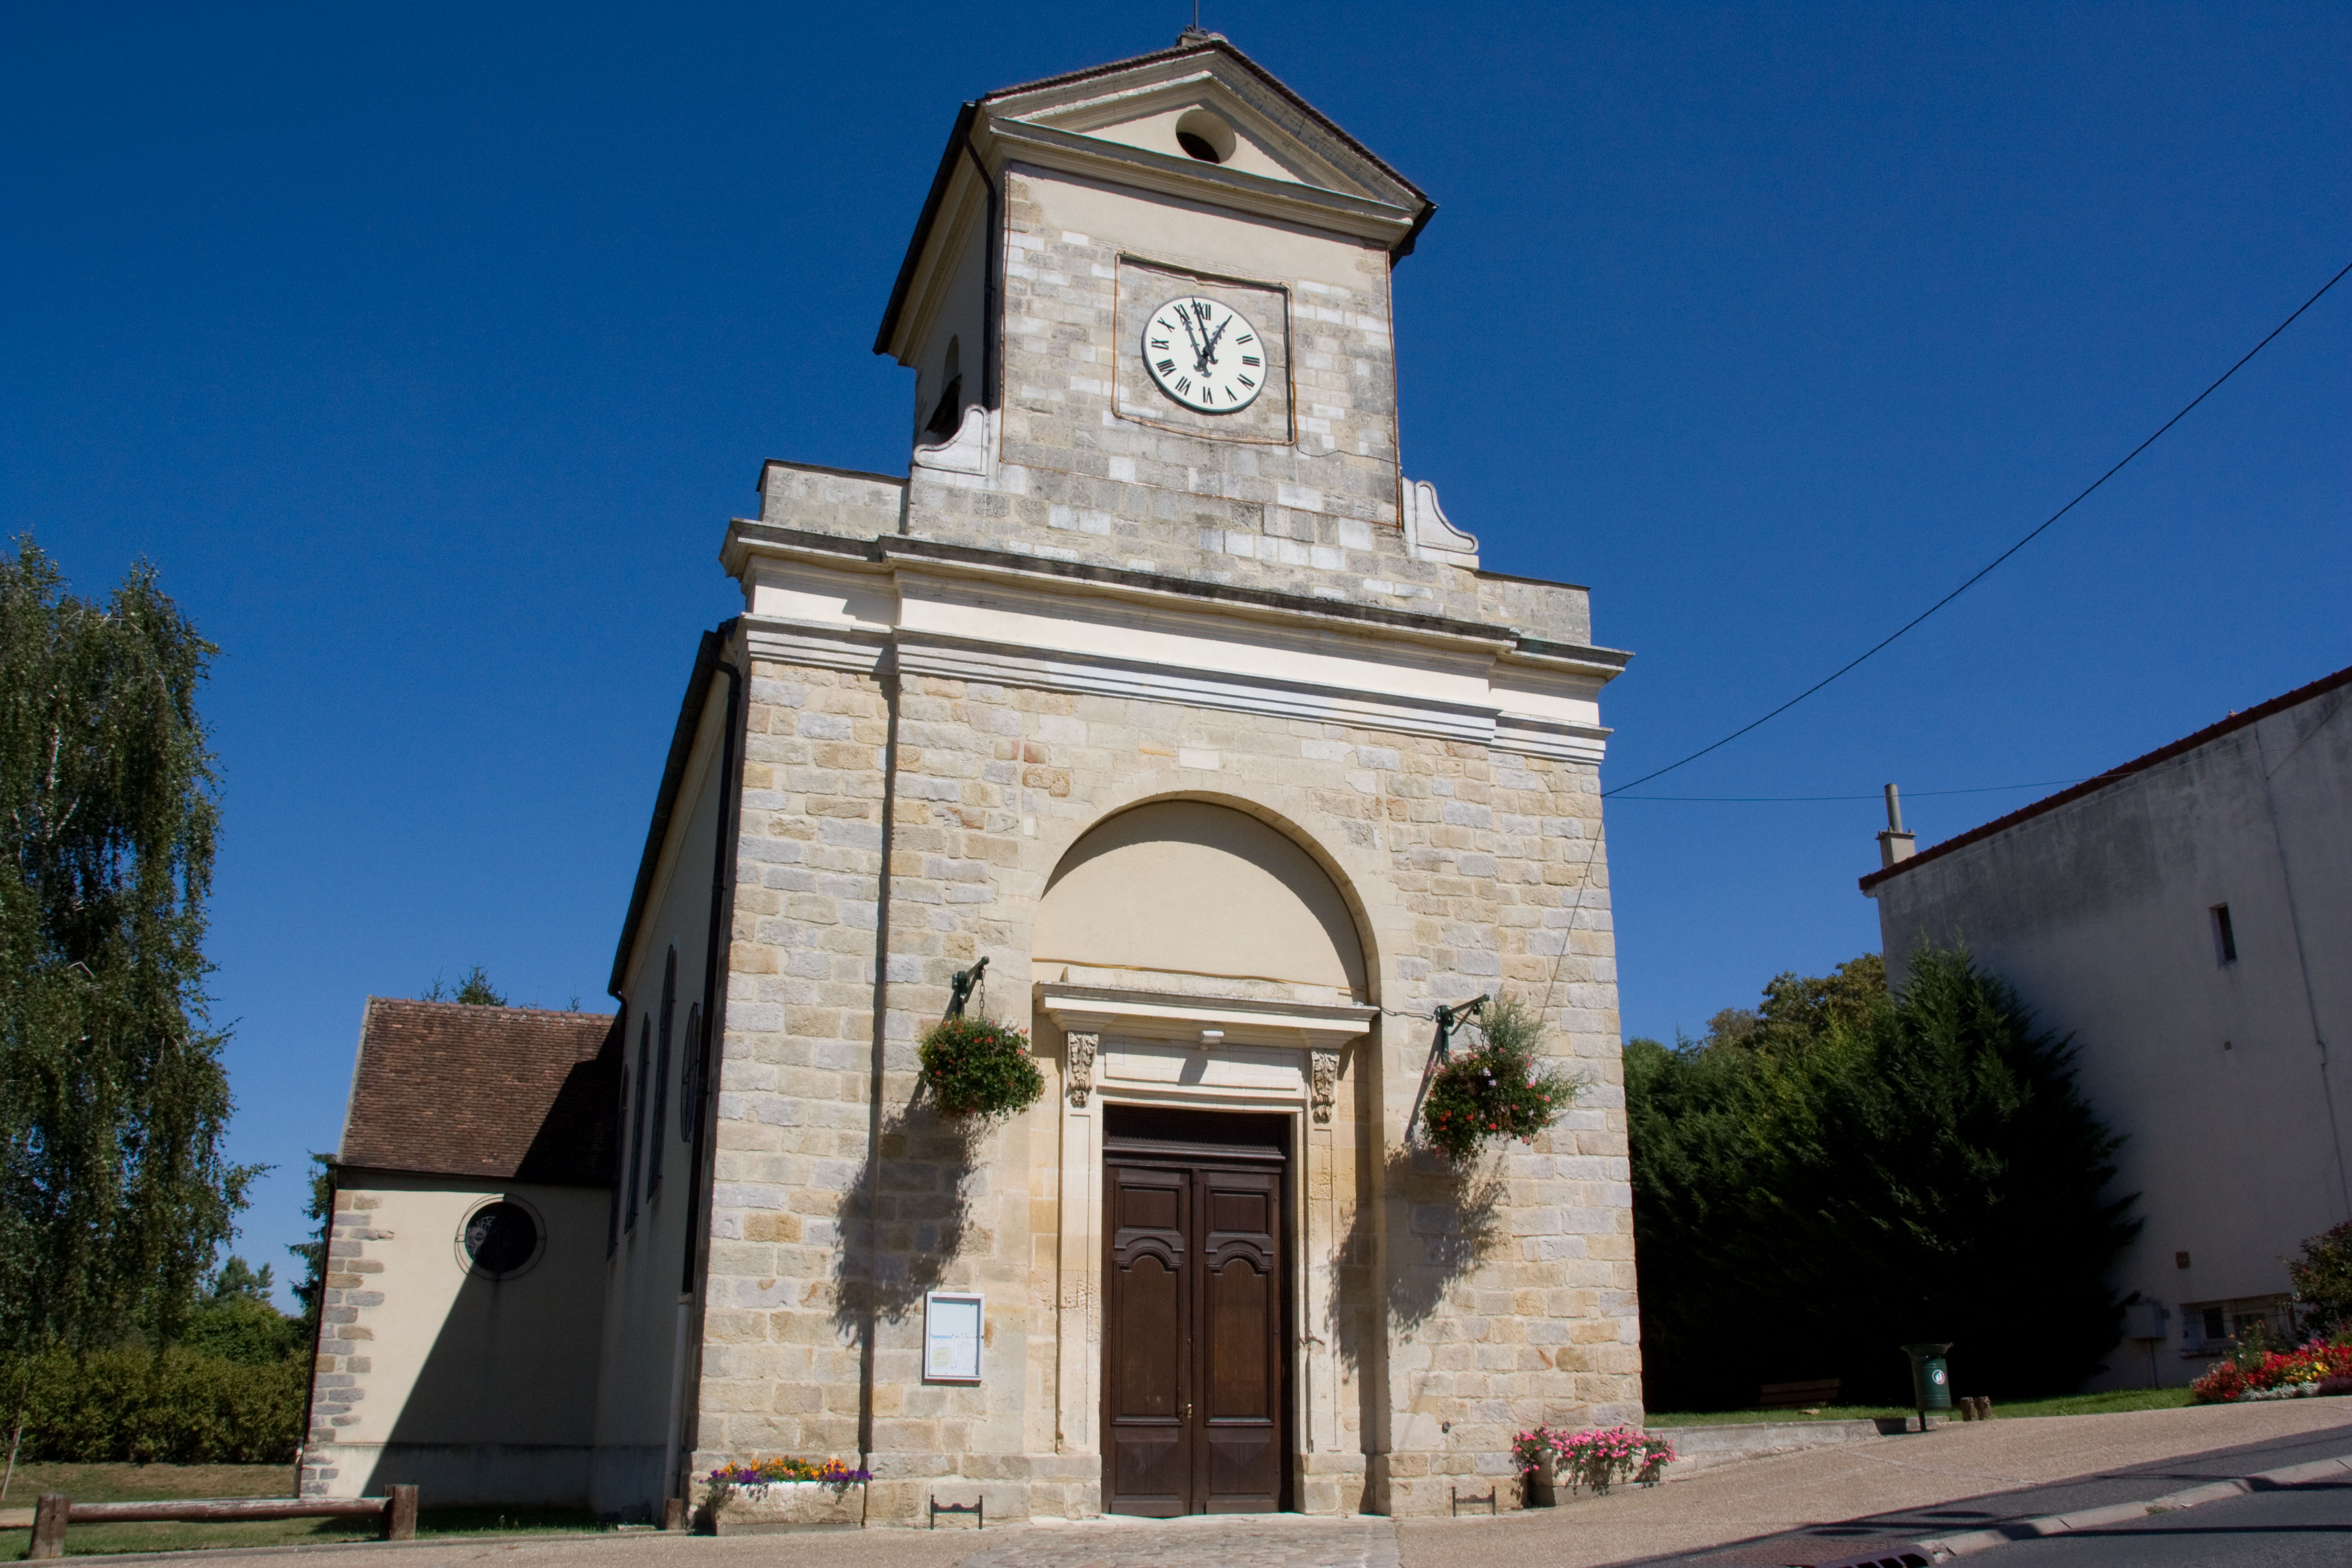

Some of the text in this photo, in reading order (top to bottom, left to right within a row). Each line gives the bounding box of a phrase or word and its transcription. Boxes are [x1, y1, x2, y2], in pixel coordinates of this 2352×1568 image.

[1173, 304, 1190, 323] XI
[1197, 302, 1211, 320] XII
[1157, 317, 1175, 333] X
[1151, 337, 1169, 350] IX
[1236, 334, 1253, 345] II
[1156, 359, 1177, 377] VIII
[1242, 356, 1260, 367] III
[1175, 376, 1191, 396] VII
[1237, 373, 1255, 390] IV
[1203, 386, 1213, 404] VI
[1225, 385, 1237, 402] V
